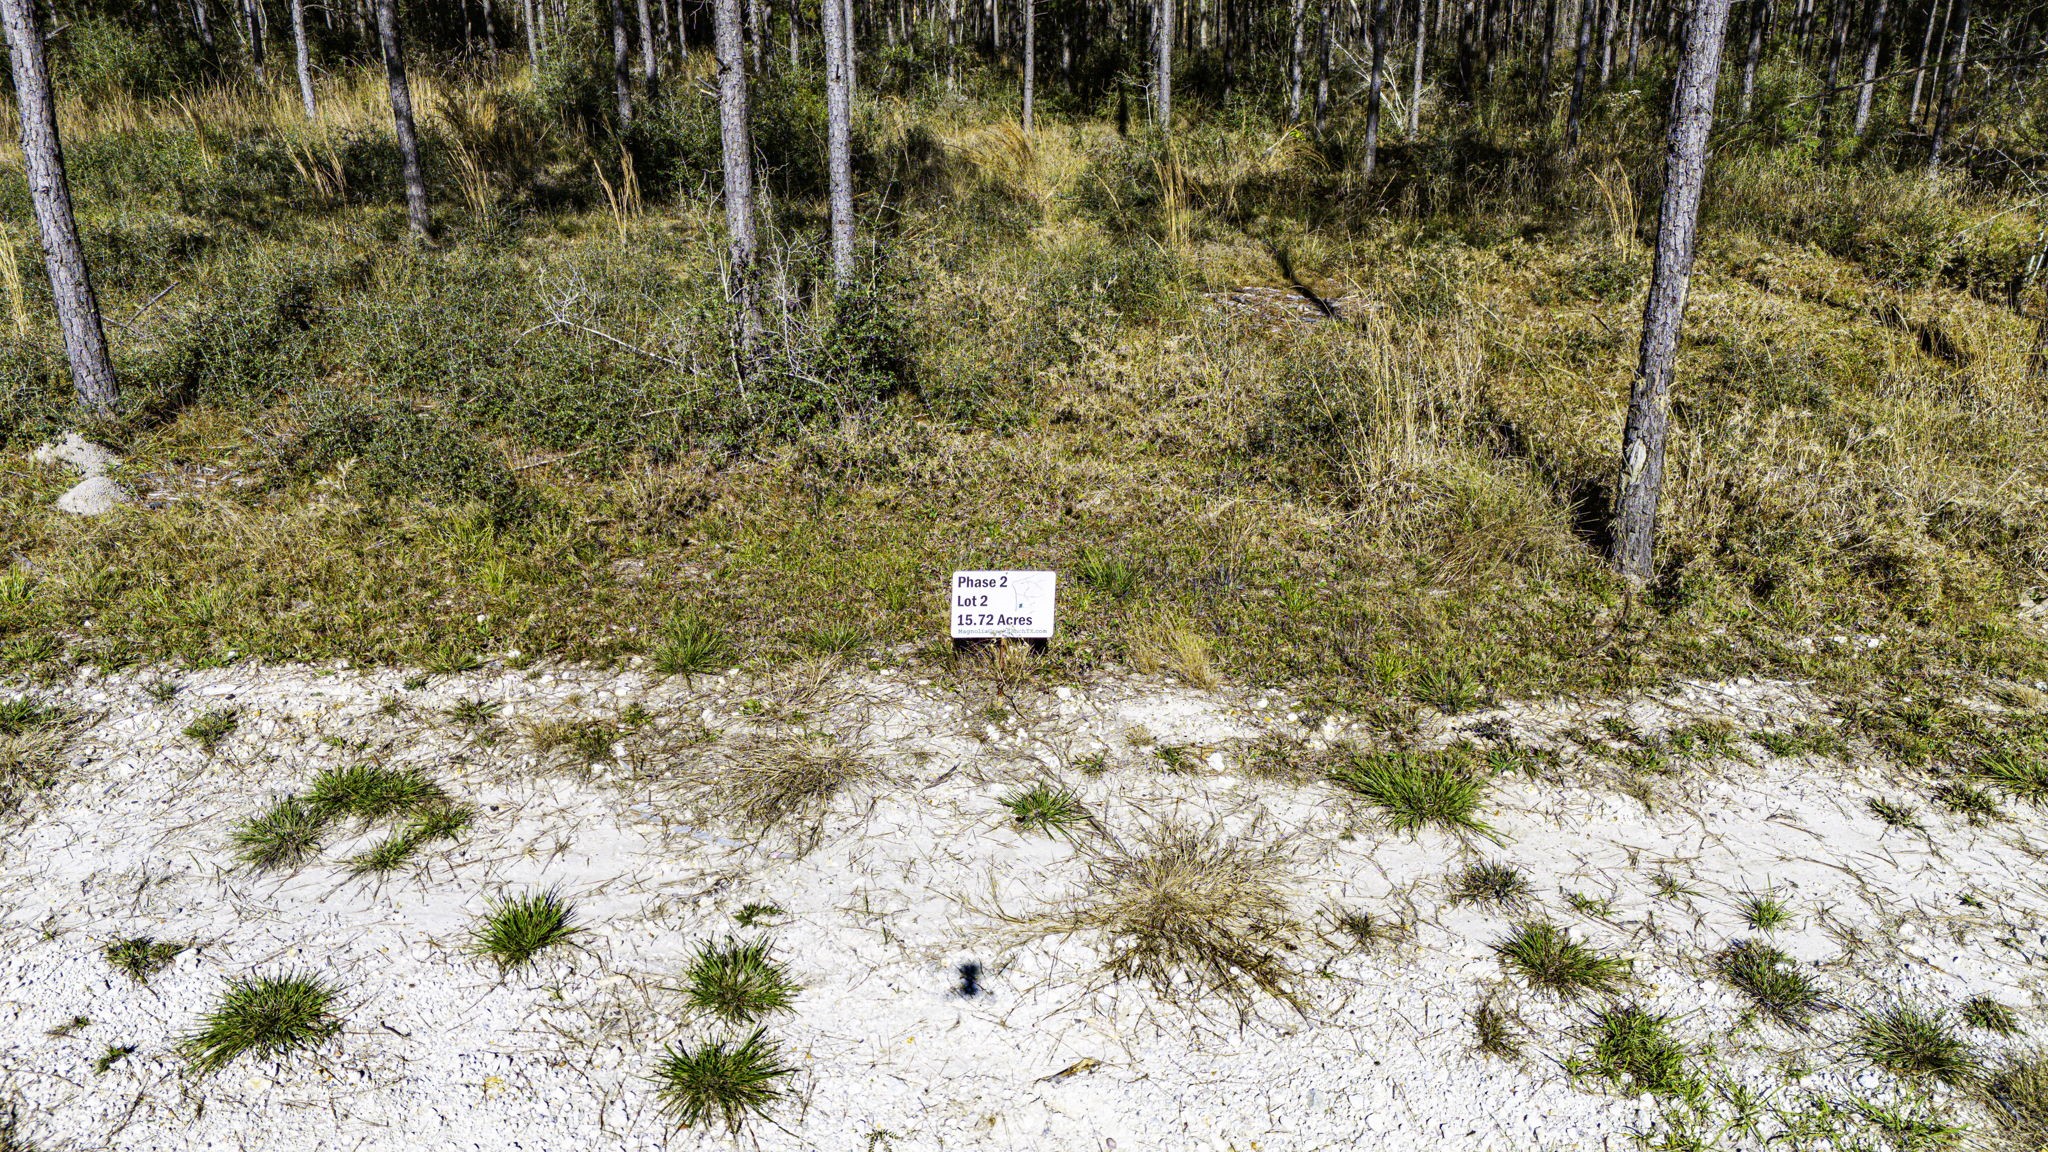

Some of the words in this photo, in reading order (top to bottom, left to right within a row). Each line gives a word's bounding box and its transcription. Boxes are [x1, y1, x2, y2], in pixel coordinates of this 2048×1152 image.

[958, 576, 996, 588] Phase
[999, 576, 1008, 588] 2
[957, 595, 977, 607] Lot
[980, 595, 988, 607] 2
[957, 614, 994, 626] 15.72
[996, 614, 1033, 626] Acres
